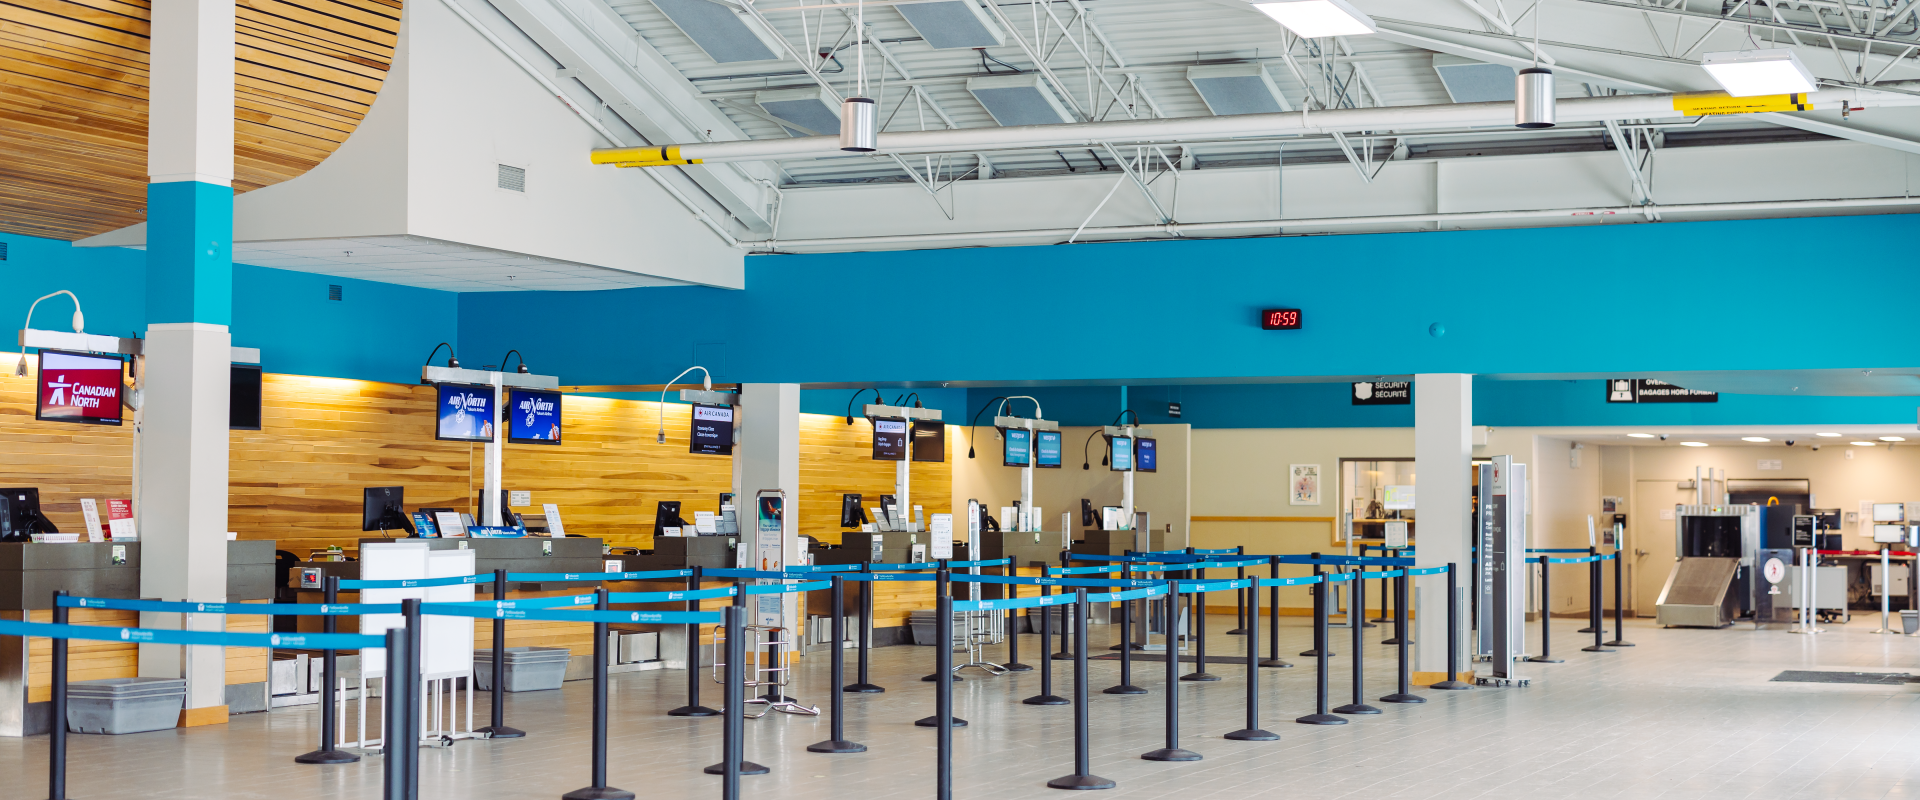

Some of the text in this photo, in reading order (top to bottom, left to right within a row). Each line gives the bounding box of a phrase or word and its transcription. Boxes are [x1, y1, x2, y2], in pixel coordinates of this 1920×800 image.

[1270, 312, 1297, 326] 10:59
[72, 382, 116, 398] CANADIAN
[1375, 389, 1407, 398] SÉCURITÉ
[70, 394, 100, 408] NORTH
[460, 393, 487, 410] NORTH
[530, 398, 554, 413] NORTH
